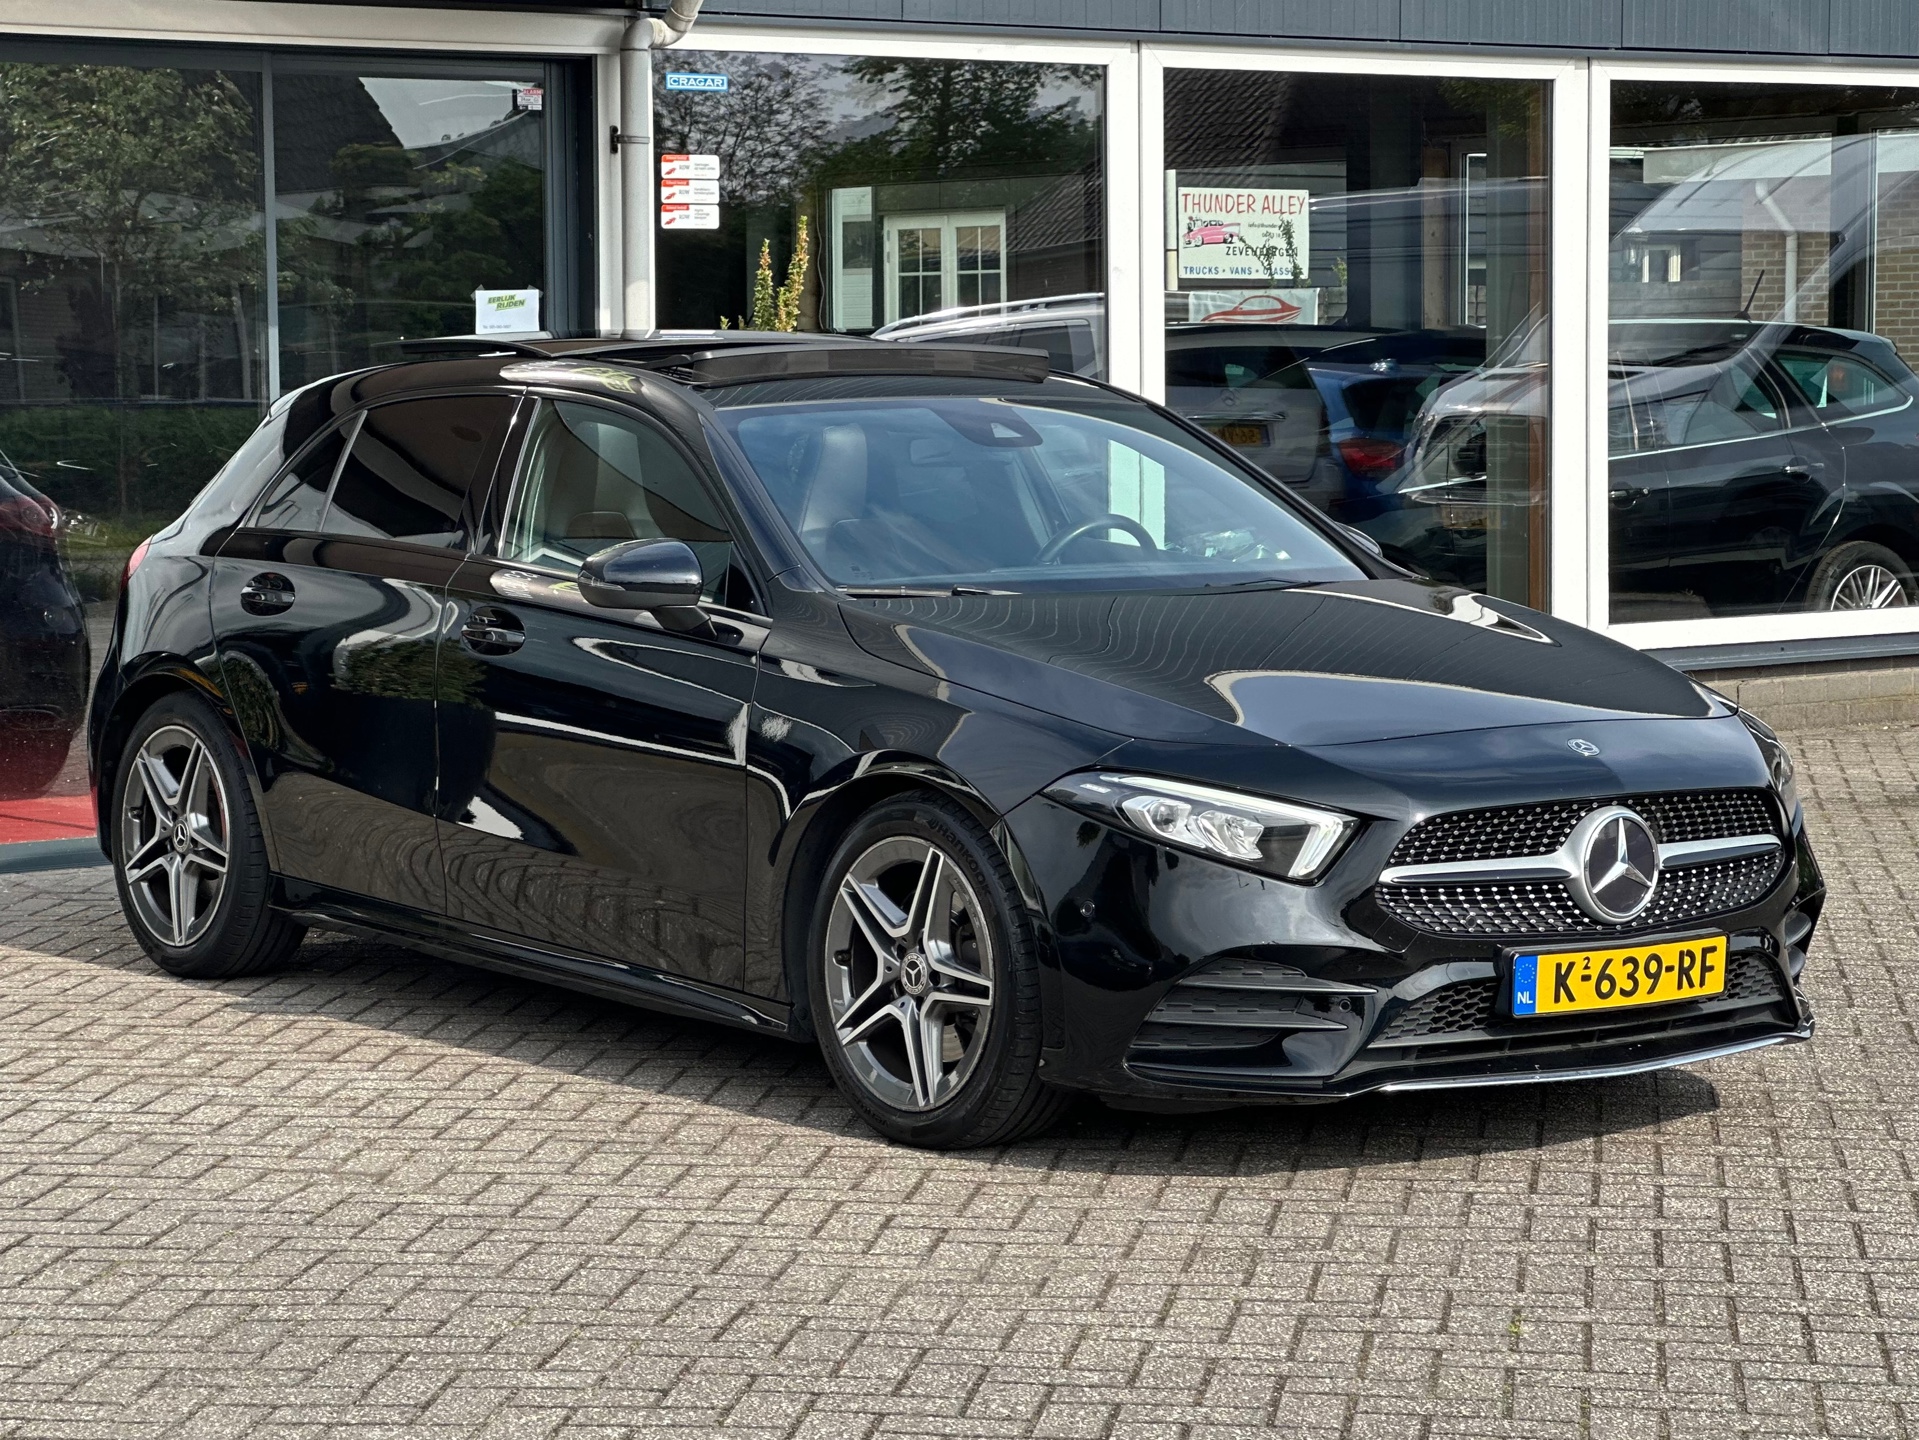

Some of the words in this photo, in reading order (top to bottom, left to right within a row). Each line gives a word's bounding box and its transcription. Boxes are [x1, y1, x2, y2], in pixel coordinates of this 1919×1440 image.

[670, 77, 723, 87] CRAGAR
[1181, 193, 1256, 214] THUNDER
[1261, 194, 1306, 215] ALLEY
[1183, 266, 1219, 276] TRUCKS
[1229, 266, 1252, 276] VANS
[487, 294, 516, 304] EERLIJK
[497, 299, 525, 309] RIJDEN
[1516, 991, 1534, 1004] NL
